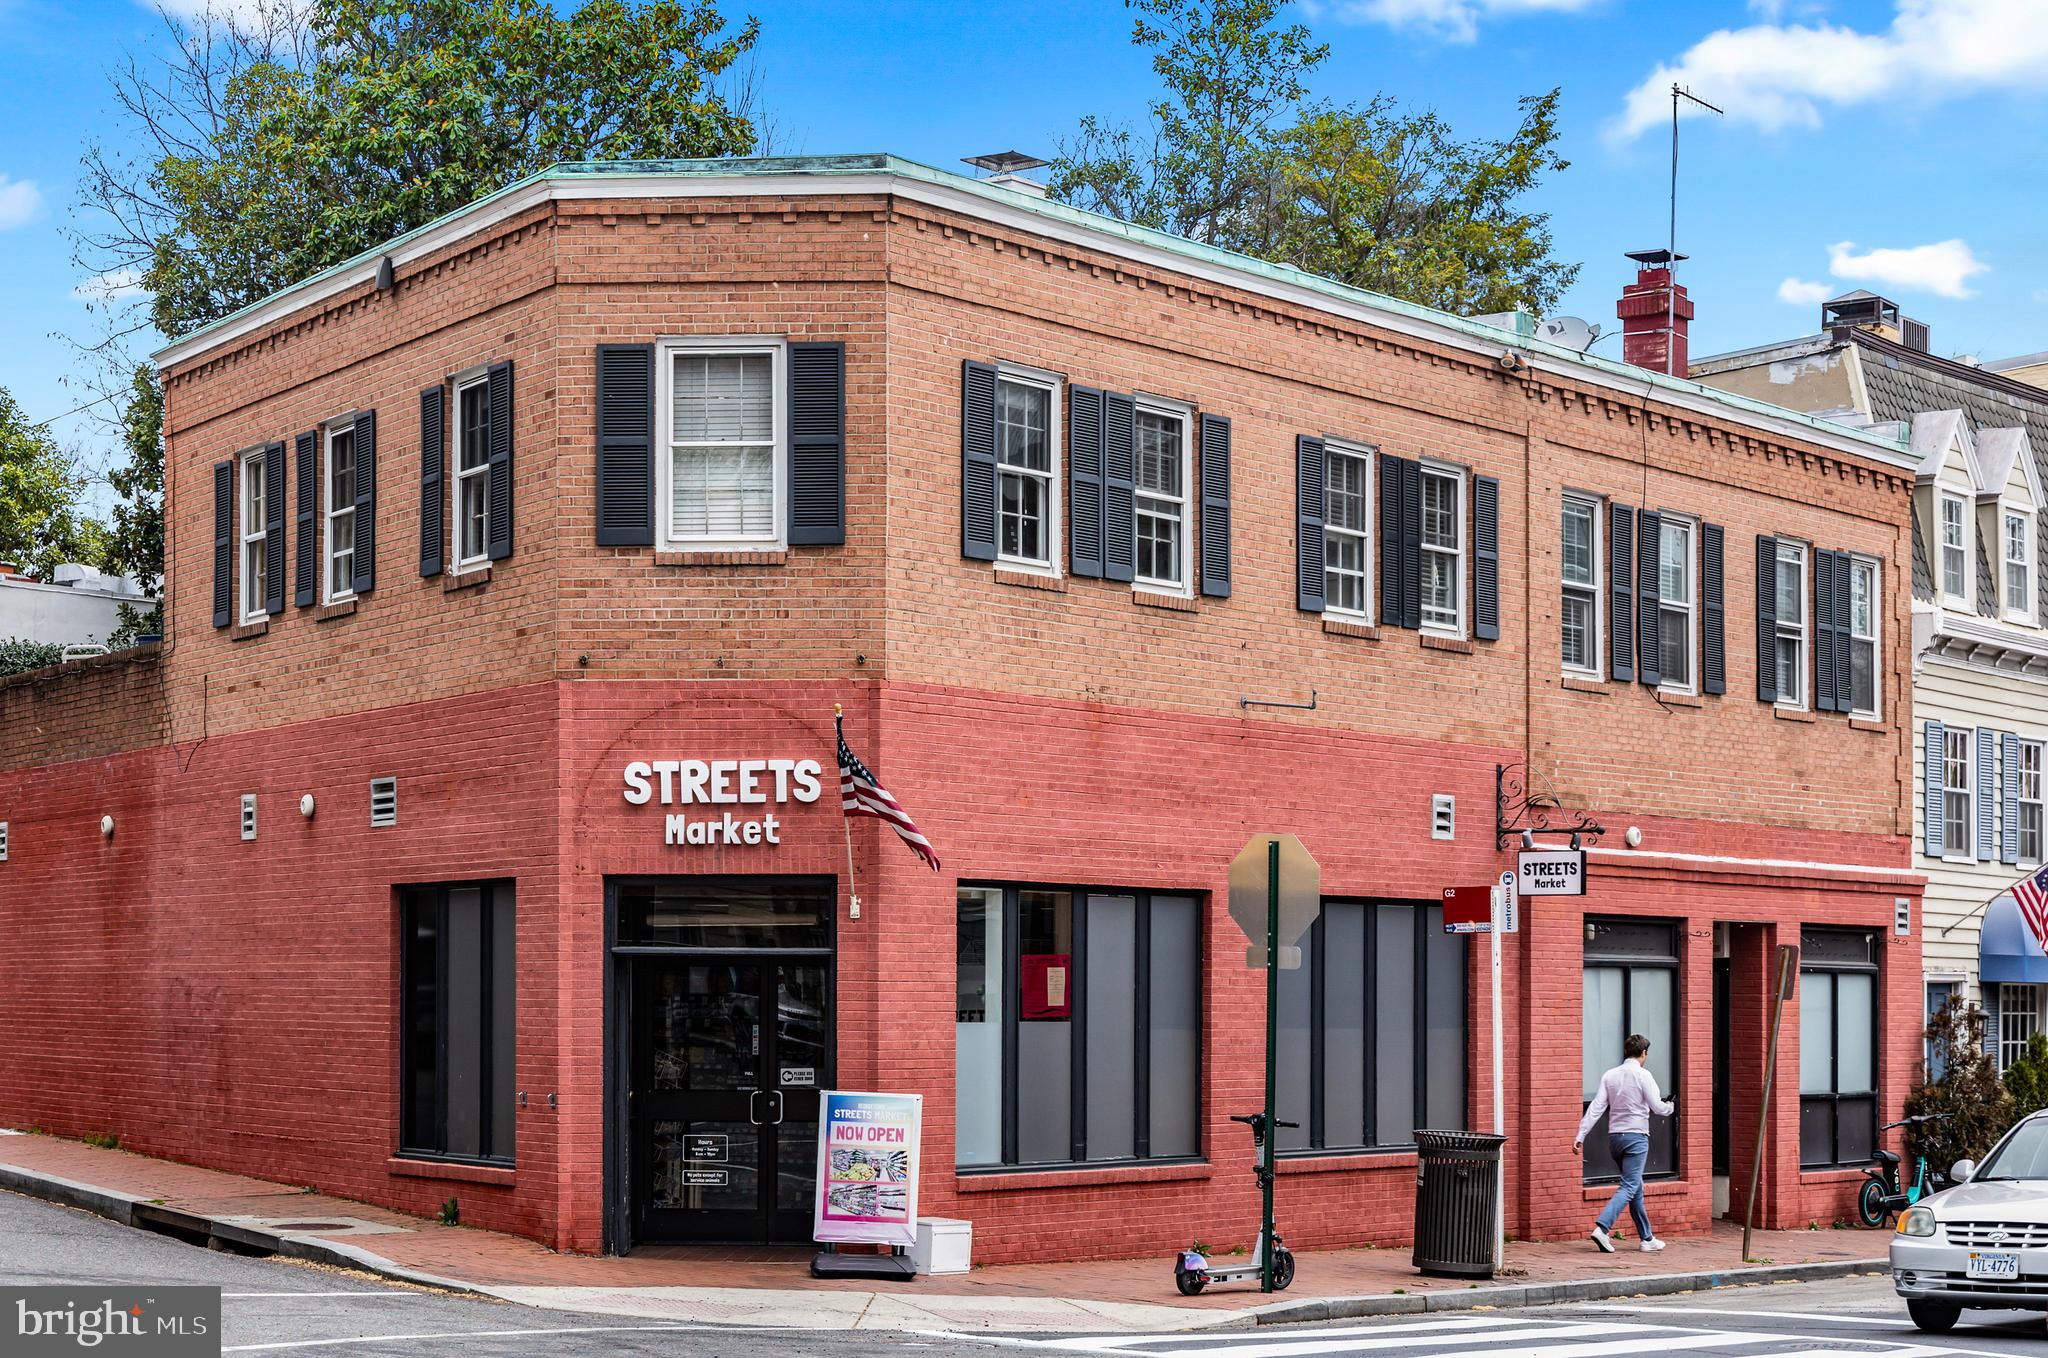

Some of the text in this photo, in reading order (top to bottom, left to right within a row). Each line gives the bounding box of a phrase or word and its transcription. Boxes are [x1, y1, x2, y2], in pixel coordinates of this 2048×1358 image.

[623, 760, 822, 805] STREETS
[665, 812, 780, 845] Market
[1523, 862, 1577, 876] STREETS
[1534, 878, 1566, 888] Market
[1444, 889, 1456, 897] G2
[834, 1109, 907, 1121] STREETS MARKET
[836, 1125, 905, 1142] NOW OPEN
[1970, 1259, 2015, 1272] VYL-4776
